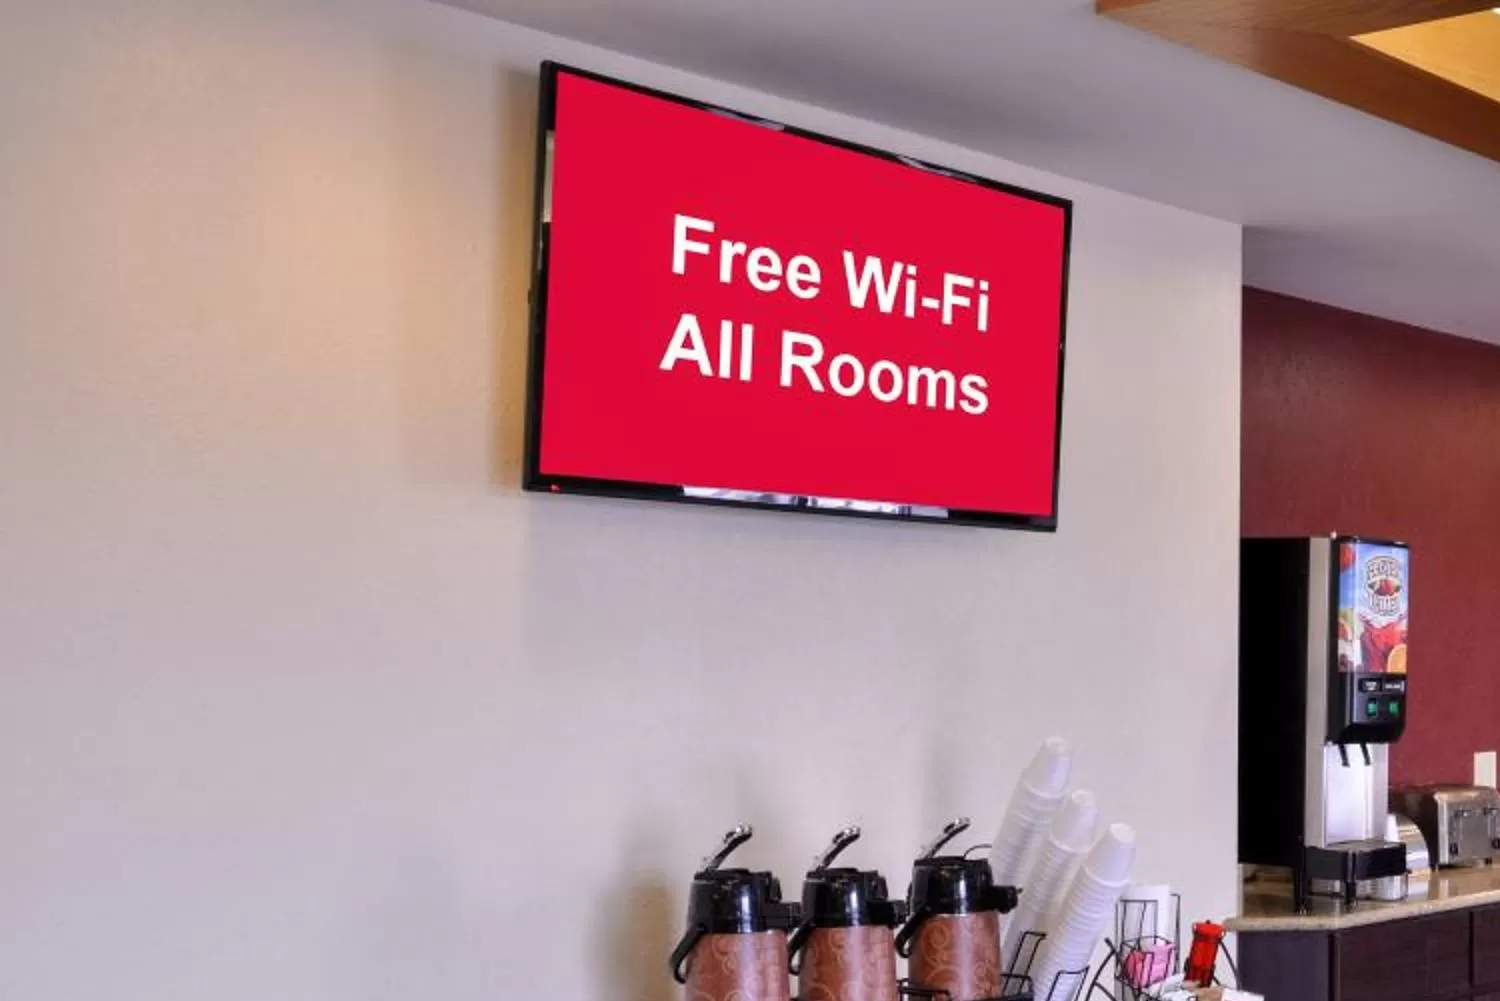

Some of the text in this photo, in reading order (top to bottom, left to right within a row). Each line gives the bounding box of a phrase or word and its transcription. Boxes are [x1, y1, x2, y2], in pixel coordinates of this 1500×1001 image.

[673, 214, 989, 332] Free Wi-Fi
[660, 314, 989, 415] All Rooms
